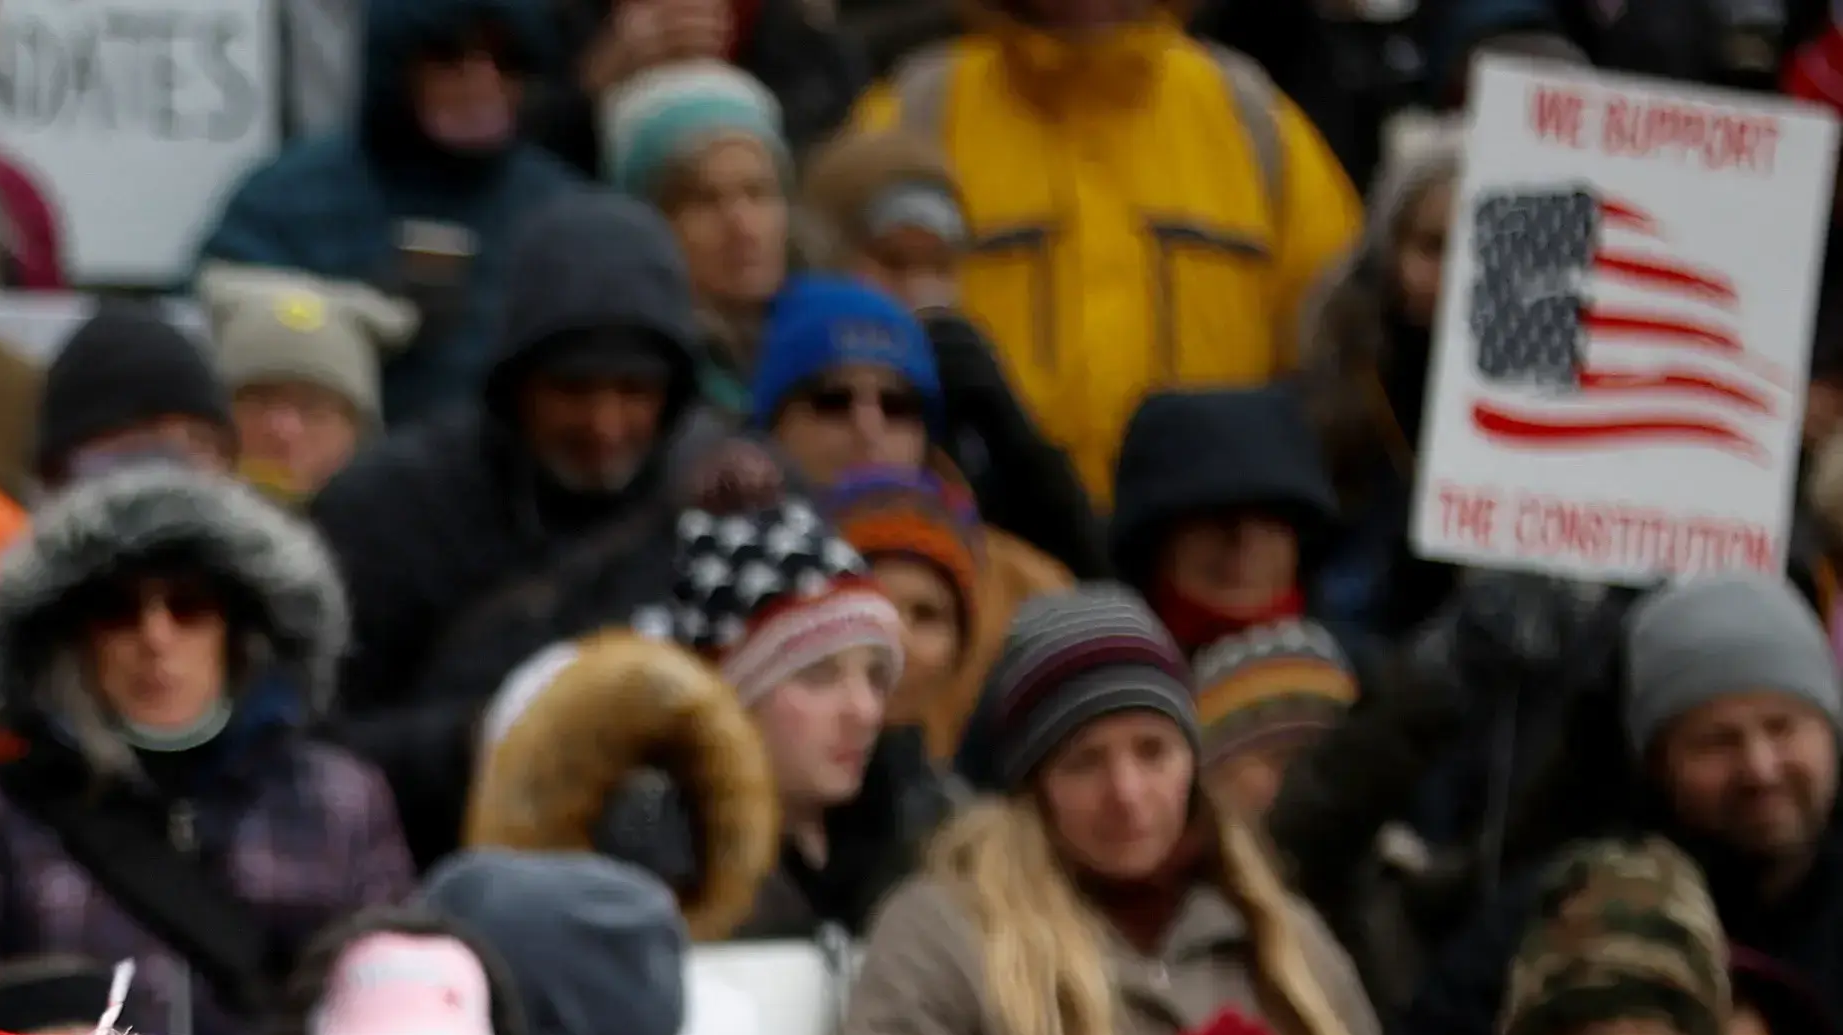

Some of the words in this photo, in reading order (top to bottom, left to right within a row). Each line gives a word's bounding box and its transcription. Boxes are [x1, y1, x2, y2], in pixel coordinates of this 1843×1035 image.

[1530, 86, 1585, 147] WE
[1601, 96, 1779, 174] SUPPORT
[1437, 489, 1496, 547] THE
[1512, 494, 1779, 578] CONSTITUTION
